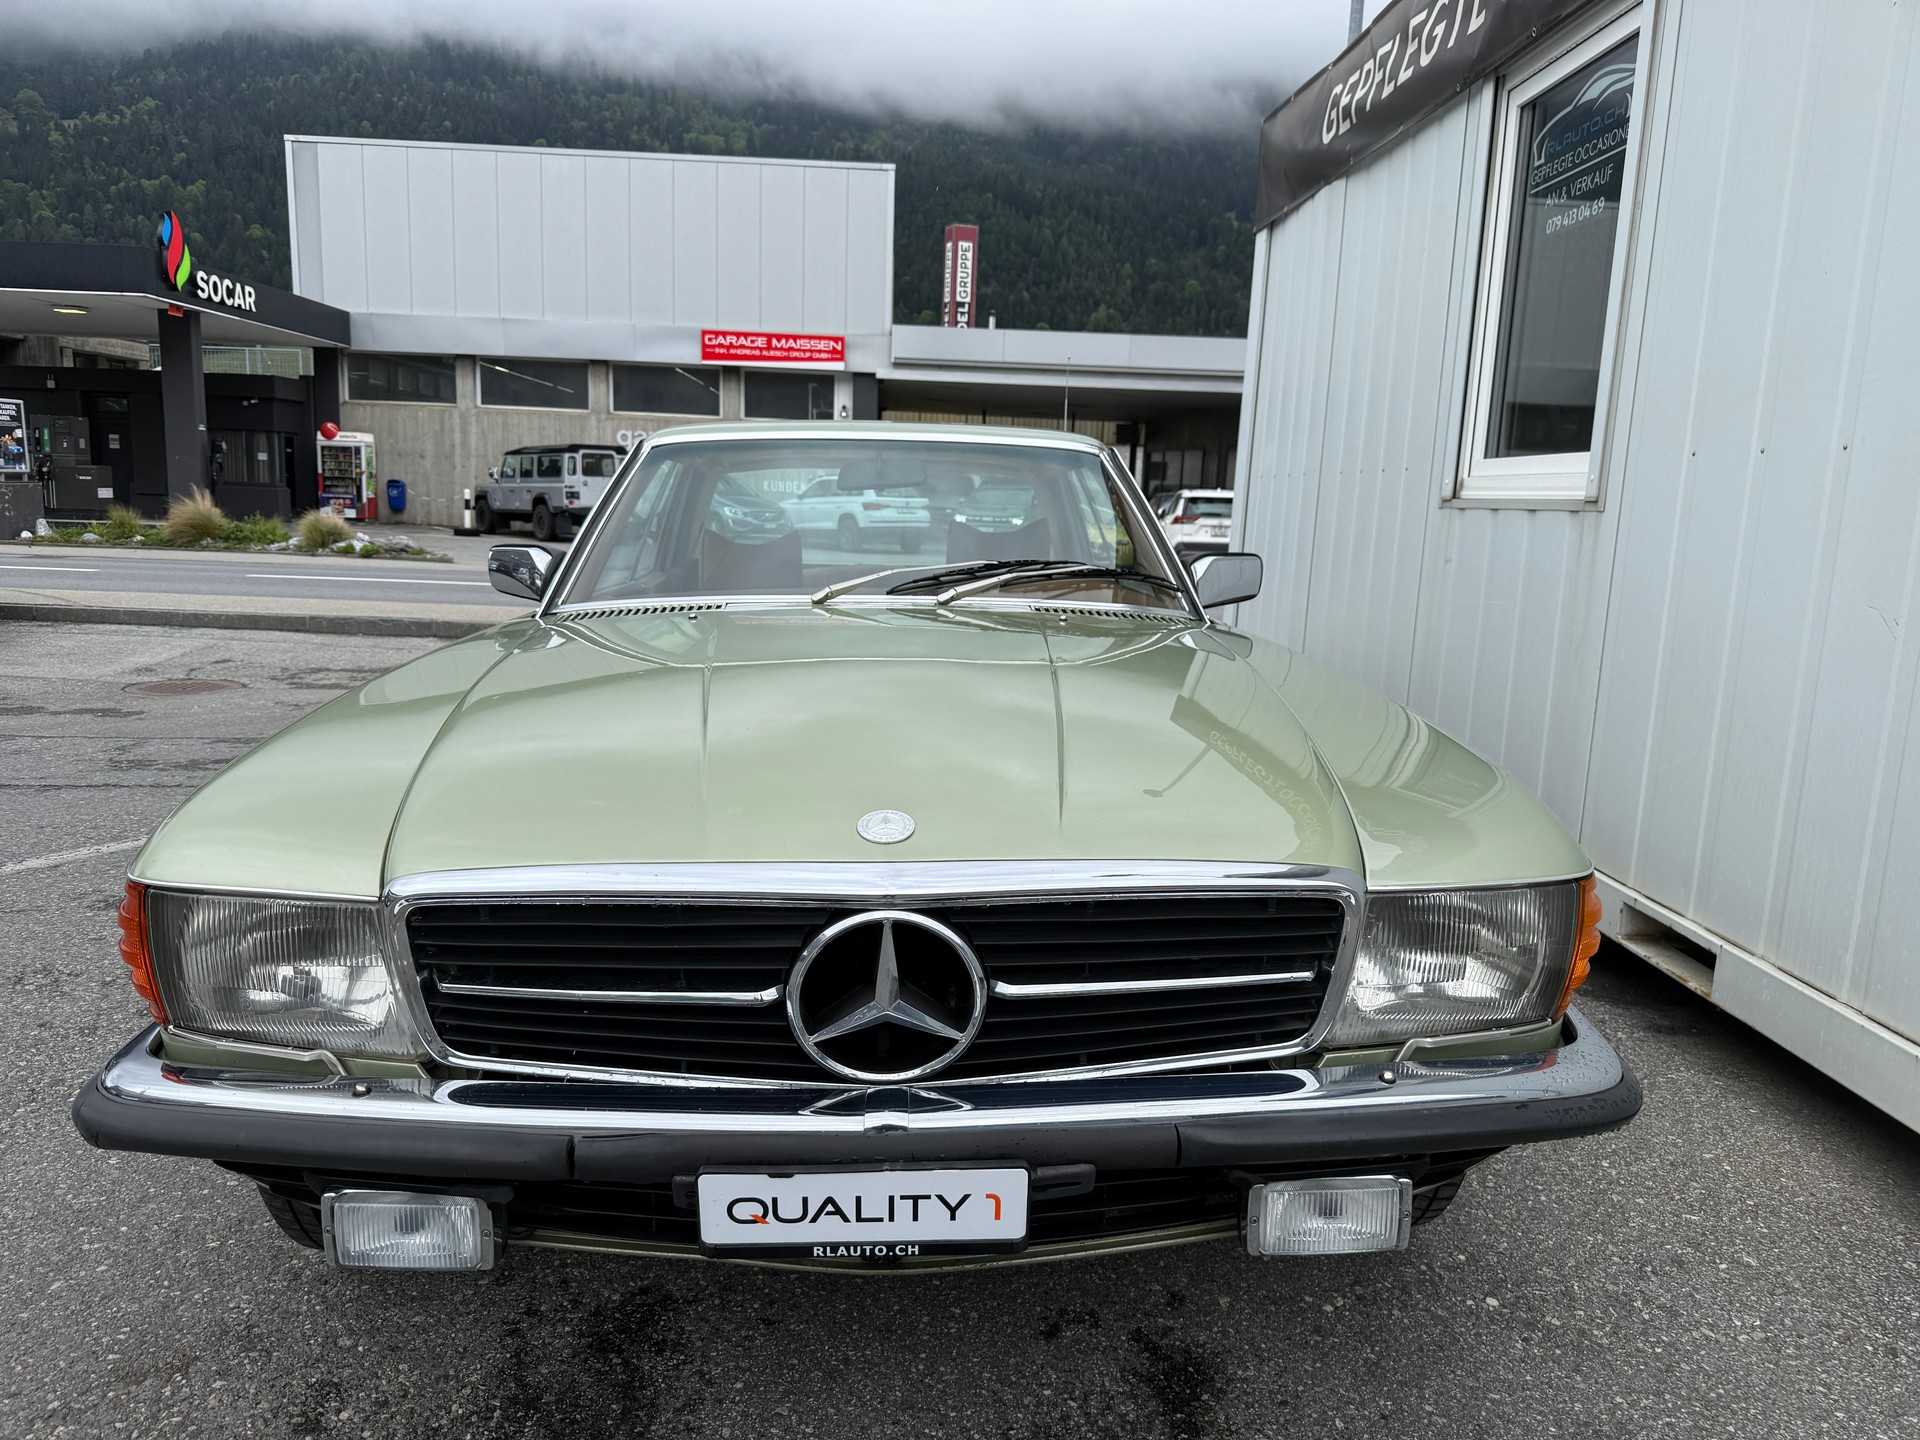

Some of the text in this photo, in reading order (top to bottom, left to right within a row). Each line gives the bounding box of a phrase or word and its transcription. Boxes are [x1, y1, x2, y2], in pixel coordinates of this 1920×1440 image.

[1546, 101, 1626, 156] RLAUTO.CH
[1530, 151, 1574, 186] GEPFLEGTE
[1545, 163, 1614, 210] AN & VERKAUF
[1545, 196, 1605, 235] 079 413 04 69
[959, 244, 970, 299] GRUPPE
[196, 270, 257, 312] SOCAR
[704, 334, 842, 351] GARAGE MAISSEN
[729, 348, 760, 356] ANDREAS
[763, 480, 807, 493] KUNDEN
[726, 1193, 1001, 1225] QUALITY 1
[813, 1244, 919, 1257] RLAUTO.CH
